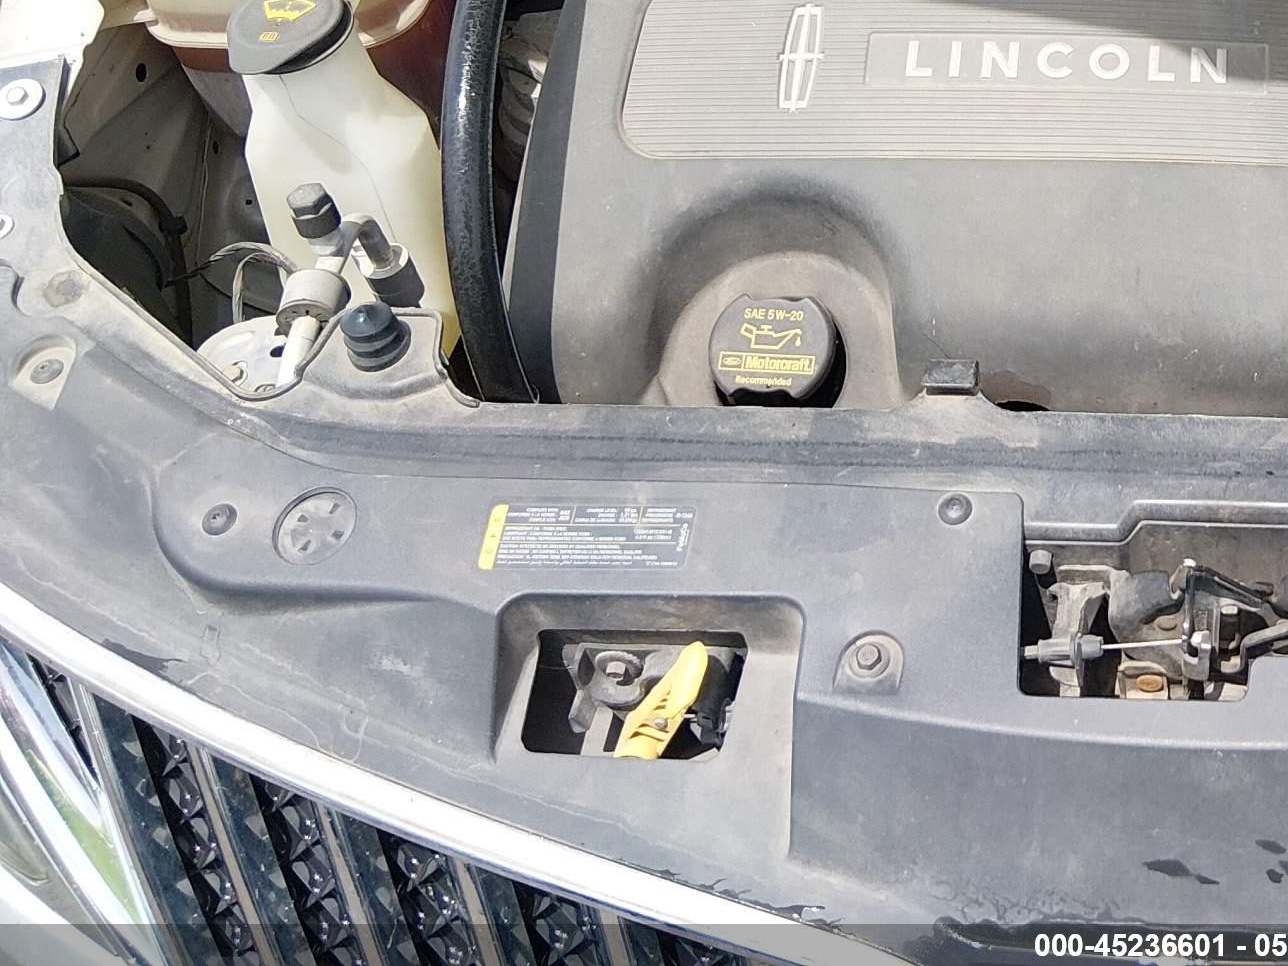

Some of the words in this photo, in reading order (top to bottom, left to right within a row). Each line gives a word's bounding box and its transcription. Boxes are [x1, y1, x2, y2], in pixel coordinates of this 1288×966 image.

[905, 40, 1229, 84] LINCOLN
[743, 308, 766, 320] SAE
[767, 308, 804, 322] 5W-20
